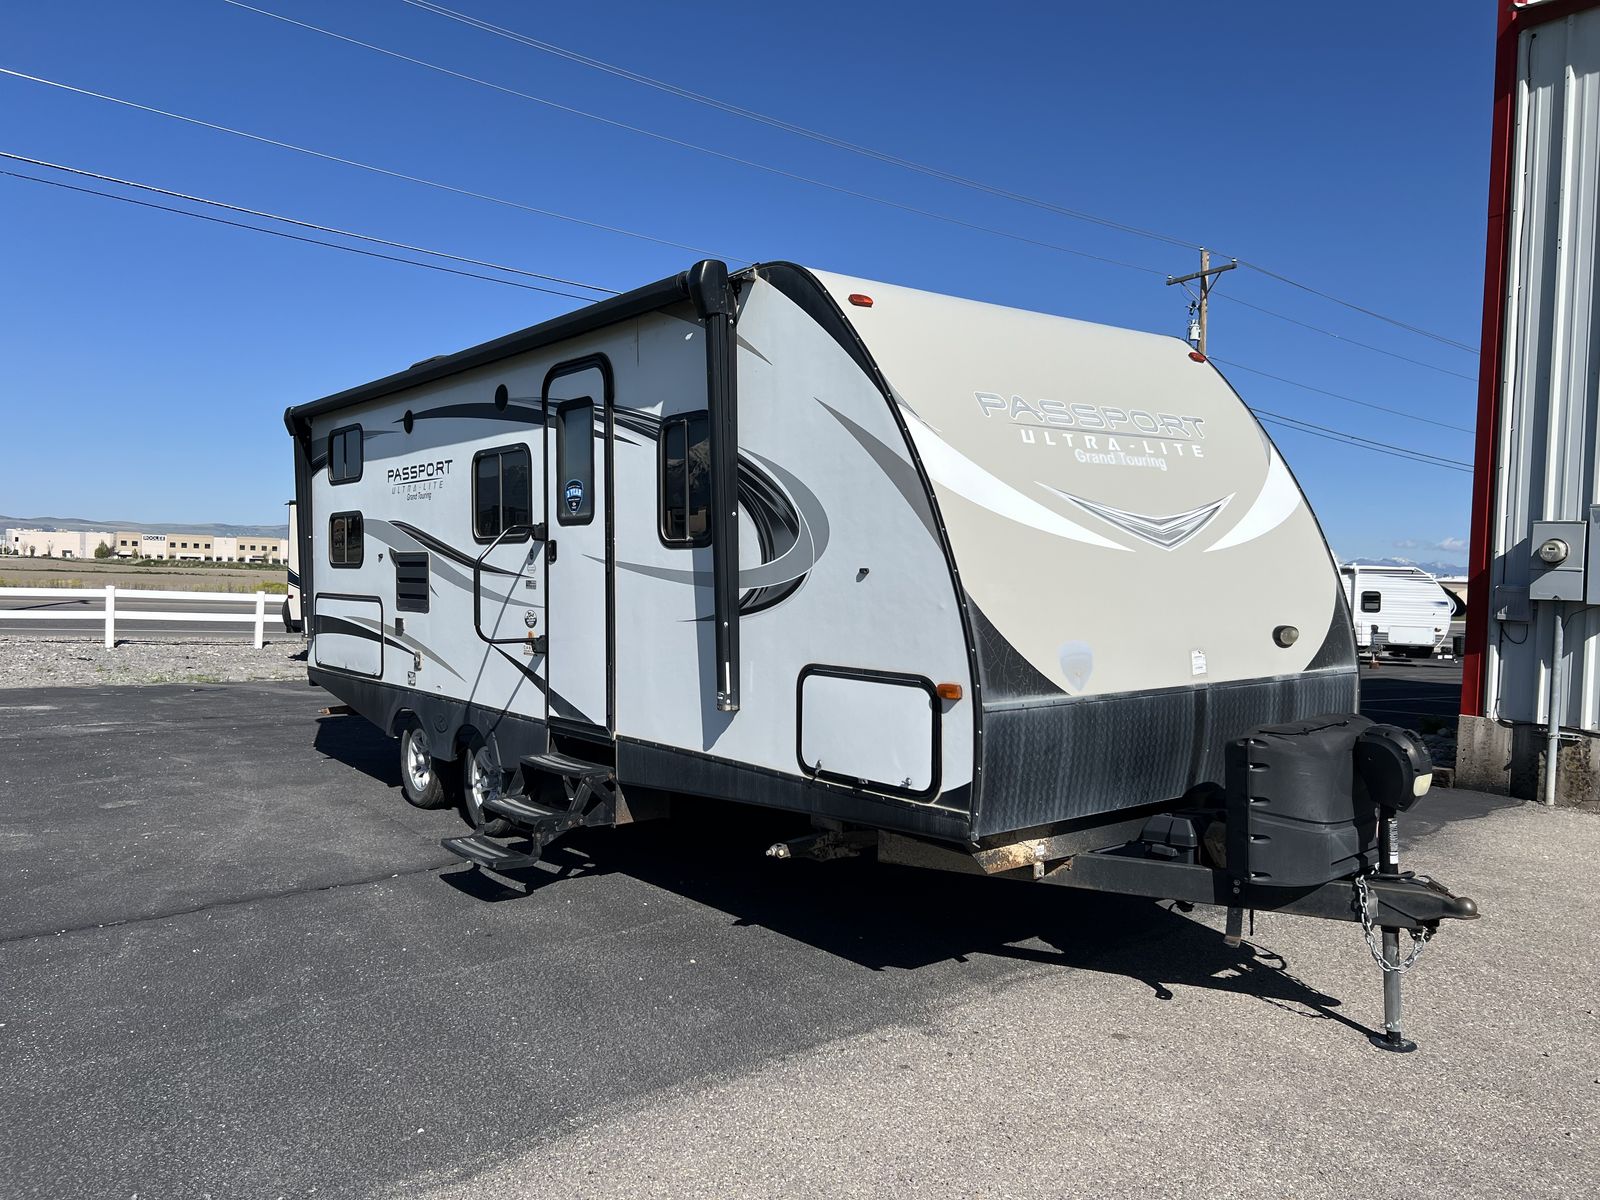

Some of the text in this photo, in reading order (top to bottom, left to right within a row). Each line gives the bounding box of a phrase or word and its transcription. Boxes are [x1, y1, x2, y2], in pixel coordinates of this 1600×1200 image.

[974, 391, 1206, 439] PASSPORT
[1020, 429, 1205, 458] ULTRA-LITE
[387, 459, 453, 483] PASSPORT
[1075, 448, 1168, 471] Grand Touring
[391, 480, 444, 495] ULTRA-LITE
